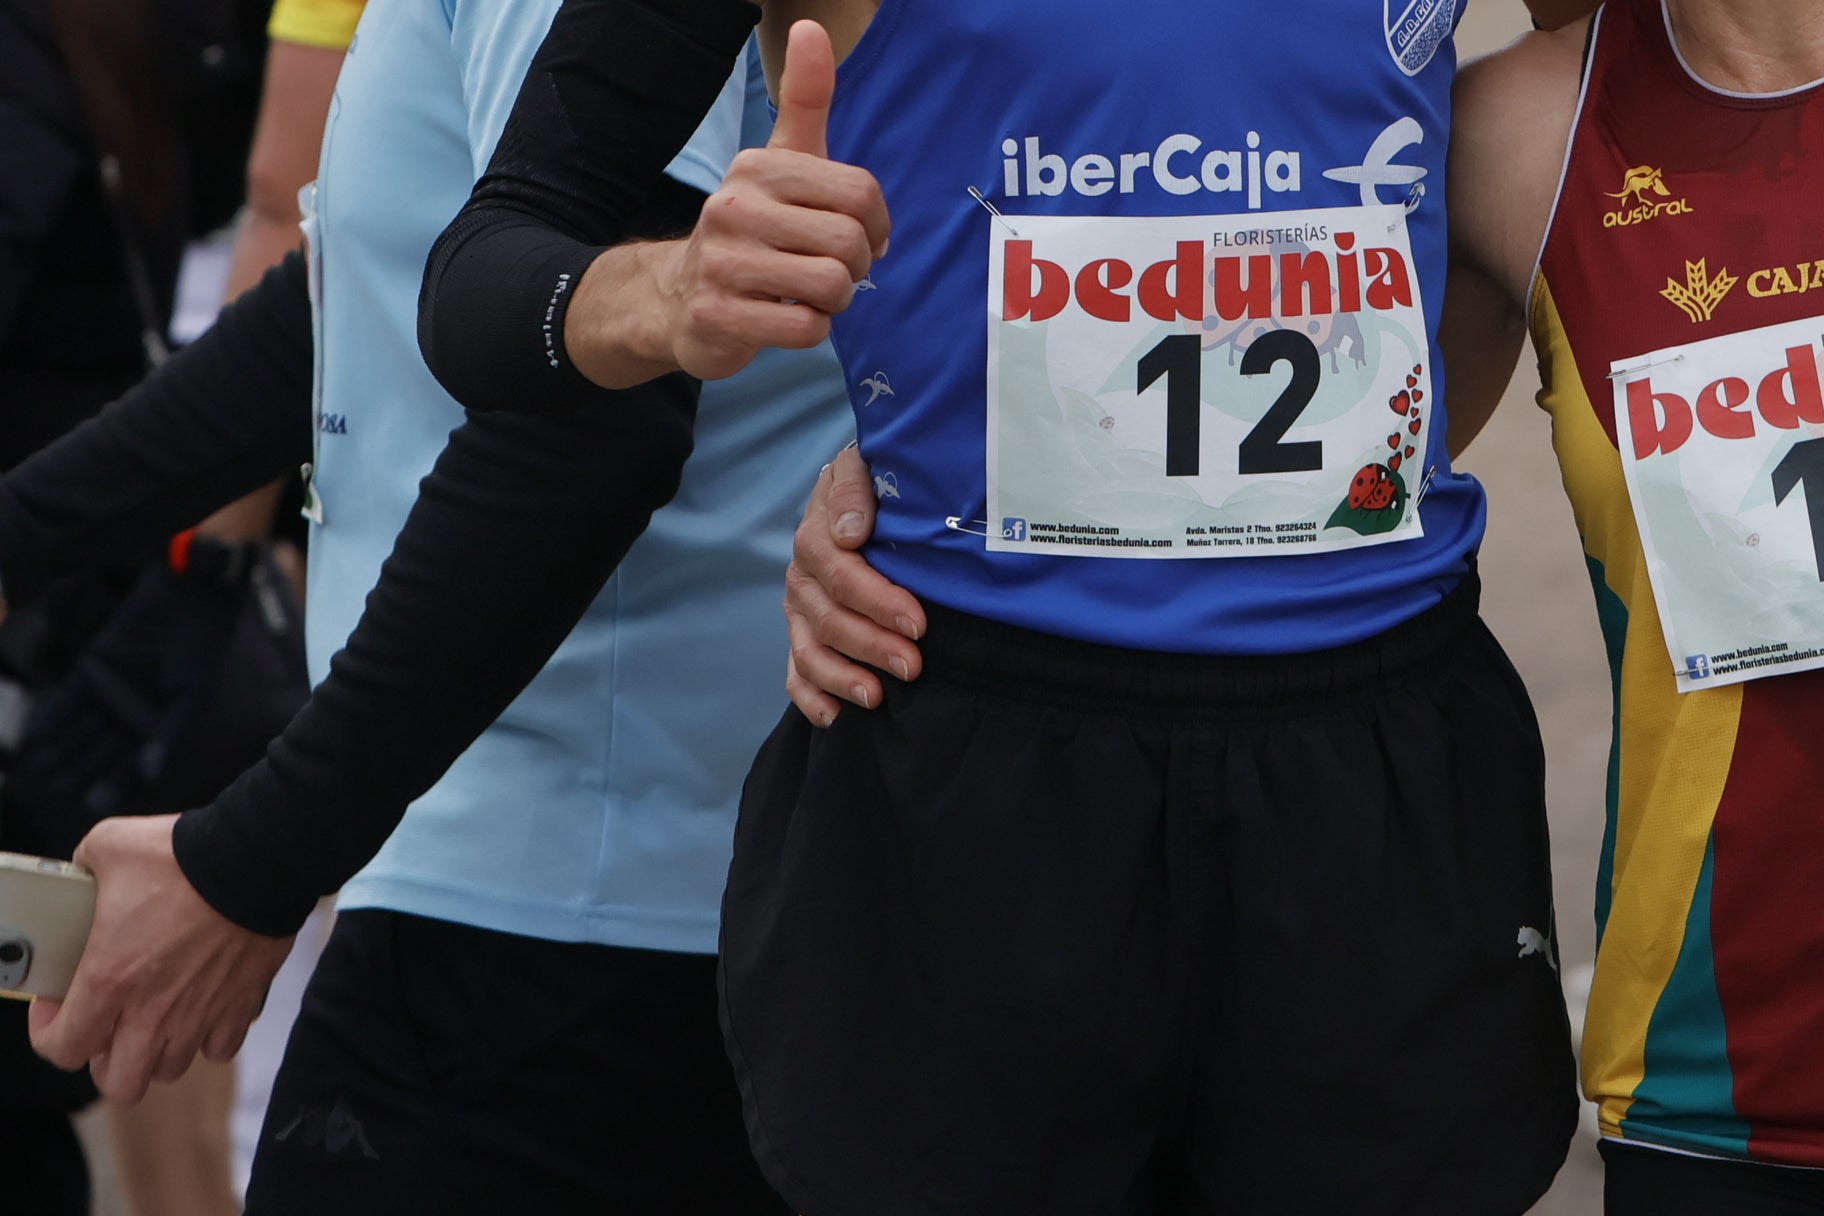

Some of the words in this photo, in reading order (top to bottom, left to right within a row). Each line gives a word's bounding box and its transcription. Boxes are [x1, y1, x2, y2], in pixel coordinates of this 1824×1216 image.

[1002, 131, 1301, 209] iberCaja
[1603, 198, 1693, 228] austral
[1213, 225, 1329, 247] FLORISTERÍAS
[1002, 231, 1413, 322] bedunia
[1137, 329, 1323, 477] 12
[1030, 522, 1119, 535] www.bedunia.com
[1209, 525, 1244, 534] Maristas
[1247, 525, 1253, 533] 2
[1030, 534, 1173, 548] www.floristeriasbedunia.com
[1711, 643, 1788, 664] www.bedunia.com
